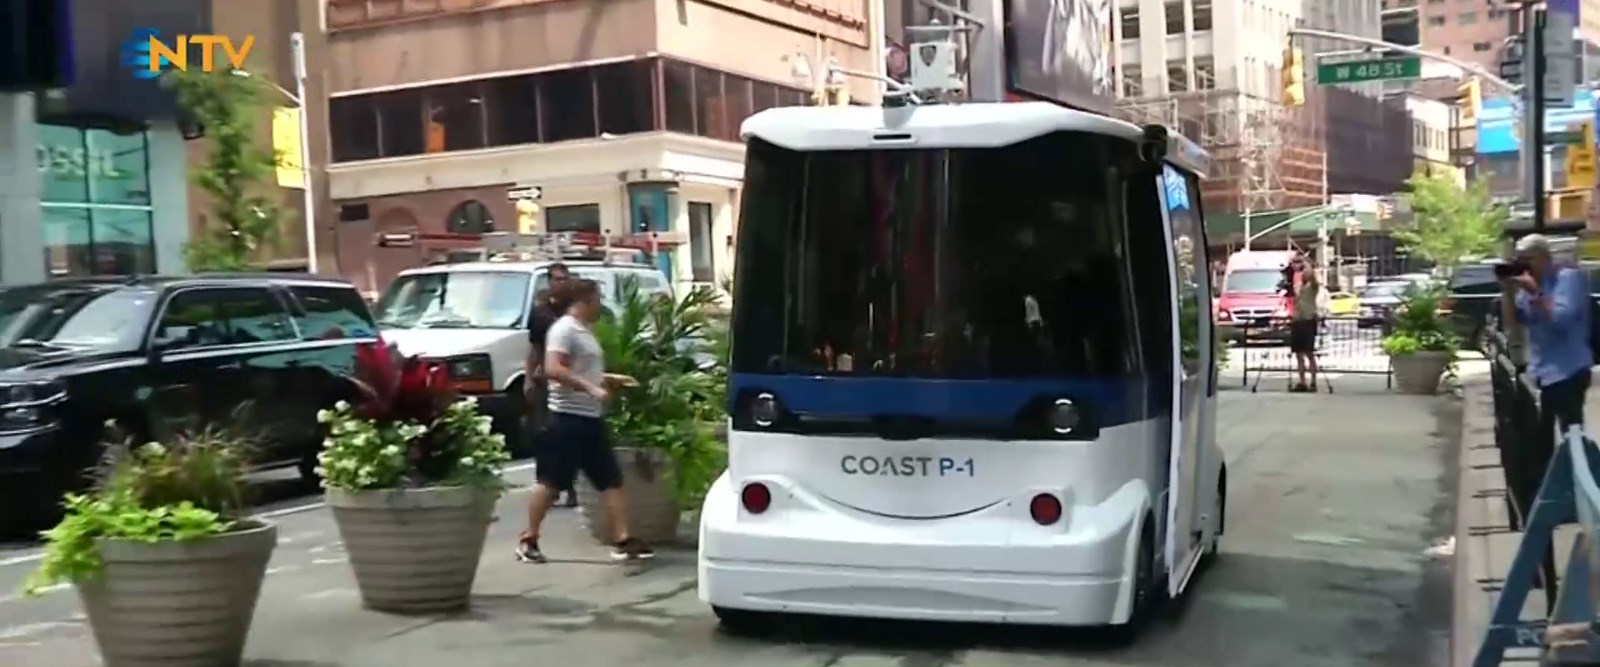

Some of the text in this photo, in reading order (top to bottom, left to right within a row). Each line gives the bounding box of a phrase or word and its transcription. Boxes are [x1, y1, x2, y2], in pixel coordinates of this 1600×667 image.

[1336, 62, 1404, 80] W 48 St
[841, 455, 973, 477] COAST P-1
